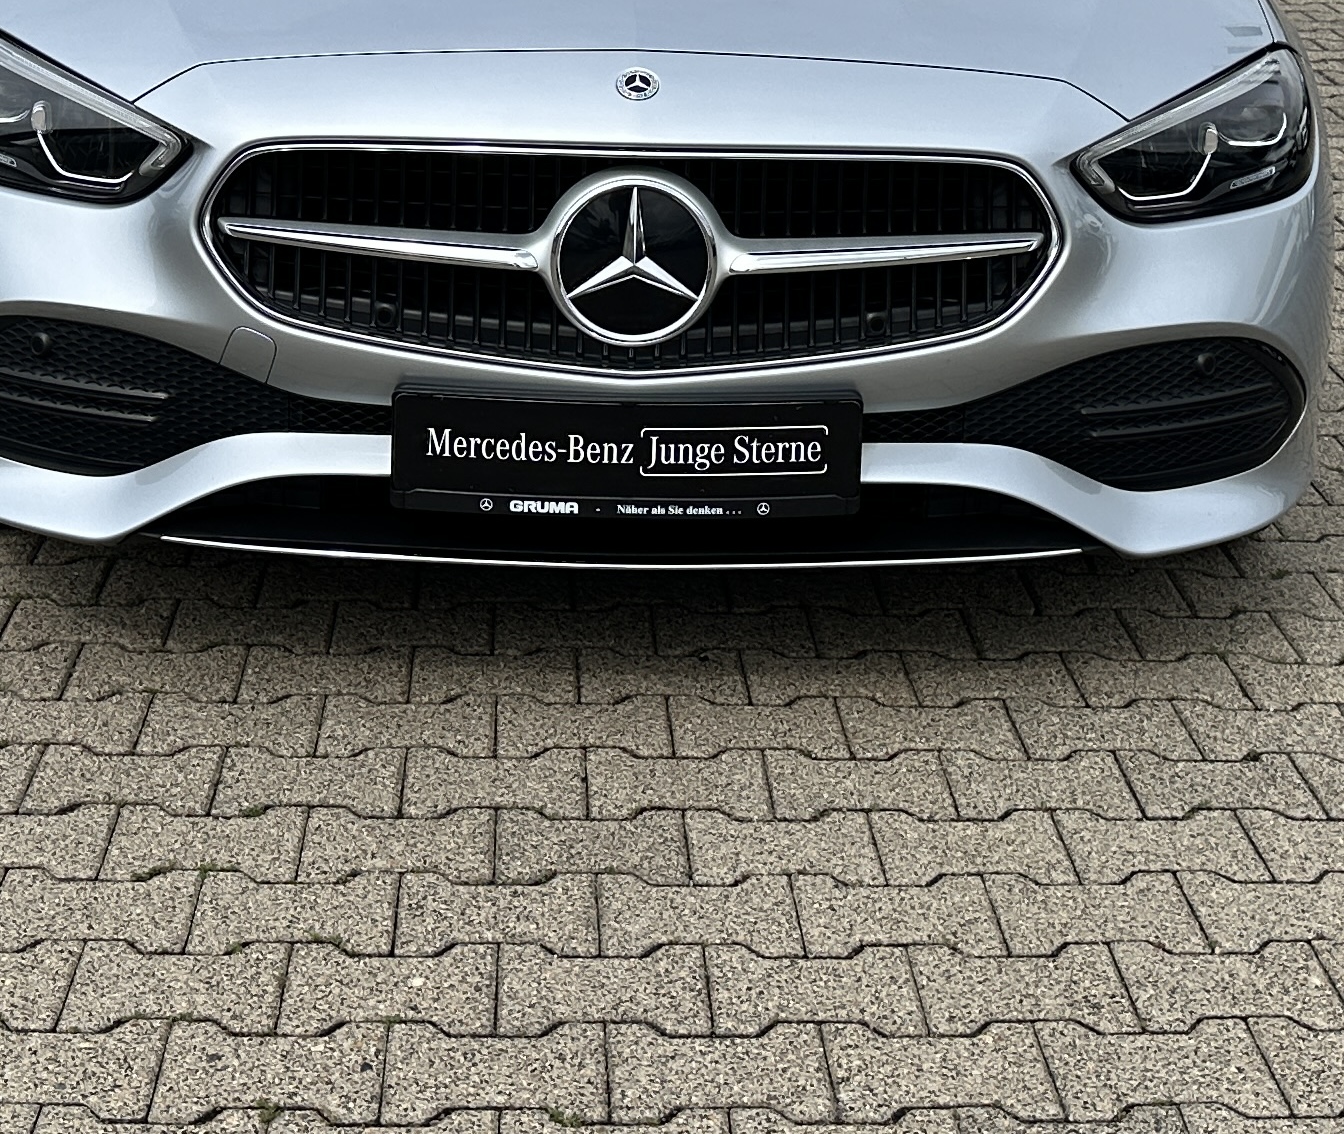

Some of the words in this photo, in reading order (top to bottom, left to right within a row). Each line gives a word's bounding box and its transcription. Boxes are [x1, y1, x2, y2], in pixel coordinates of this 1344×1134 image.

[425, 427, 635, 465] Mercedes-Benz
[646, 435, 725, 471] Junge
[733, 435, 822, 464] Sterne
[508, 499, 579, 515] GRUMA
[650, 504, 666, 515] als
[667, 505, 684, 515] Sie
